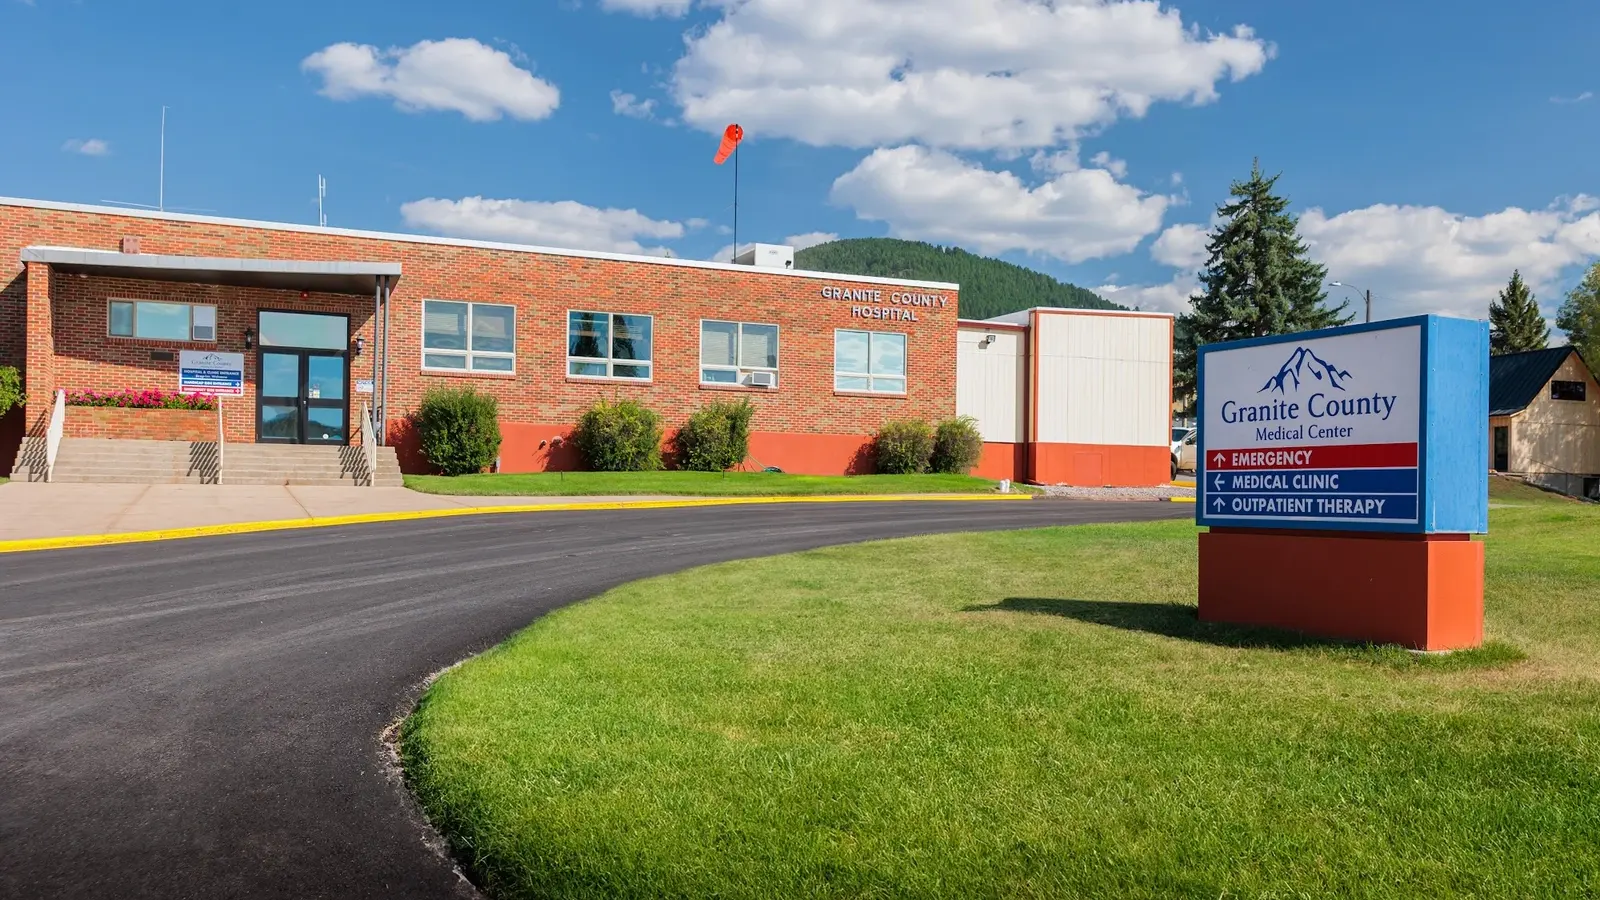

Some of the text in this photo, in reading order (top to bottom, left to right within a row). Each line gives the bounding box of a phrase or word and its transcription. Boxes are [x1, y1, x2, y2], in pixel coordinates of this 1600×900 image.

[821, 286, 948, 307] GRANITE COUNTY
[851, 305, 919, 321] HOSPITAL
[1221, 392, 1397, 424] Granite County
[1255, 424, 1353, 441] Medical Center
[1232, 450, 1313, 466] EMERGENCY
[1232, 474, 1340, 489] MEDICAL CLINIC
[1231, 497, 1386, 514] OUTPATIENT THERAPY
